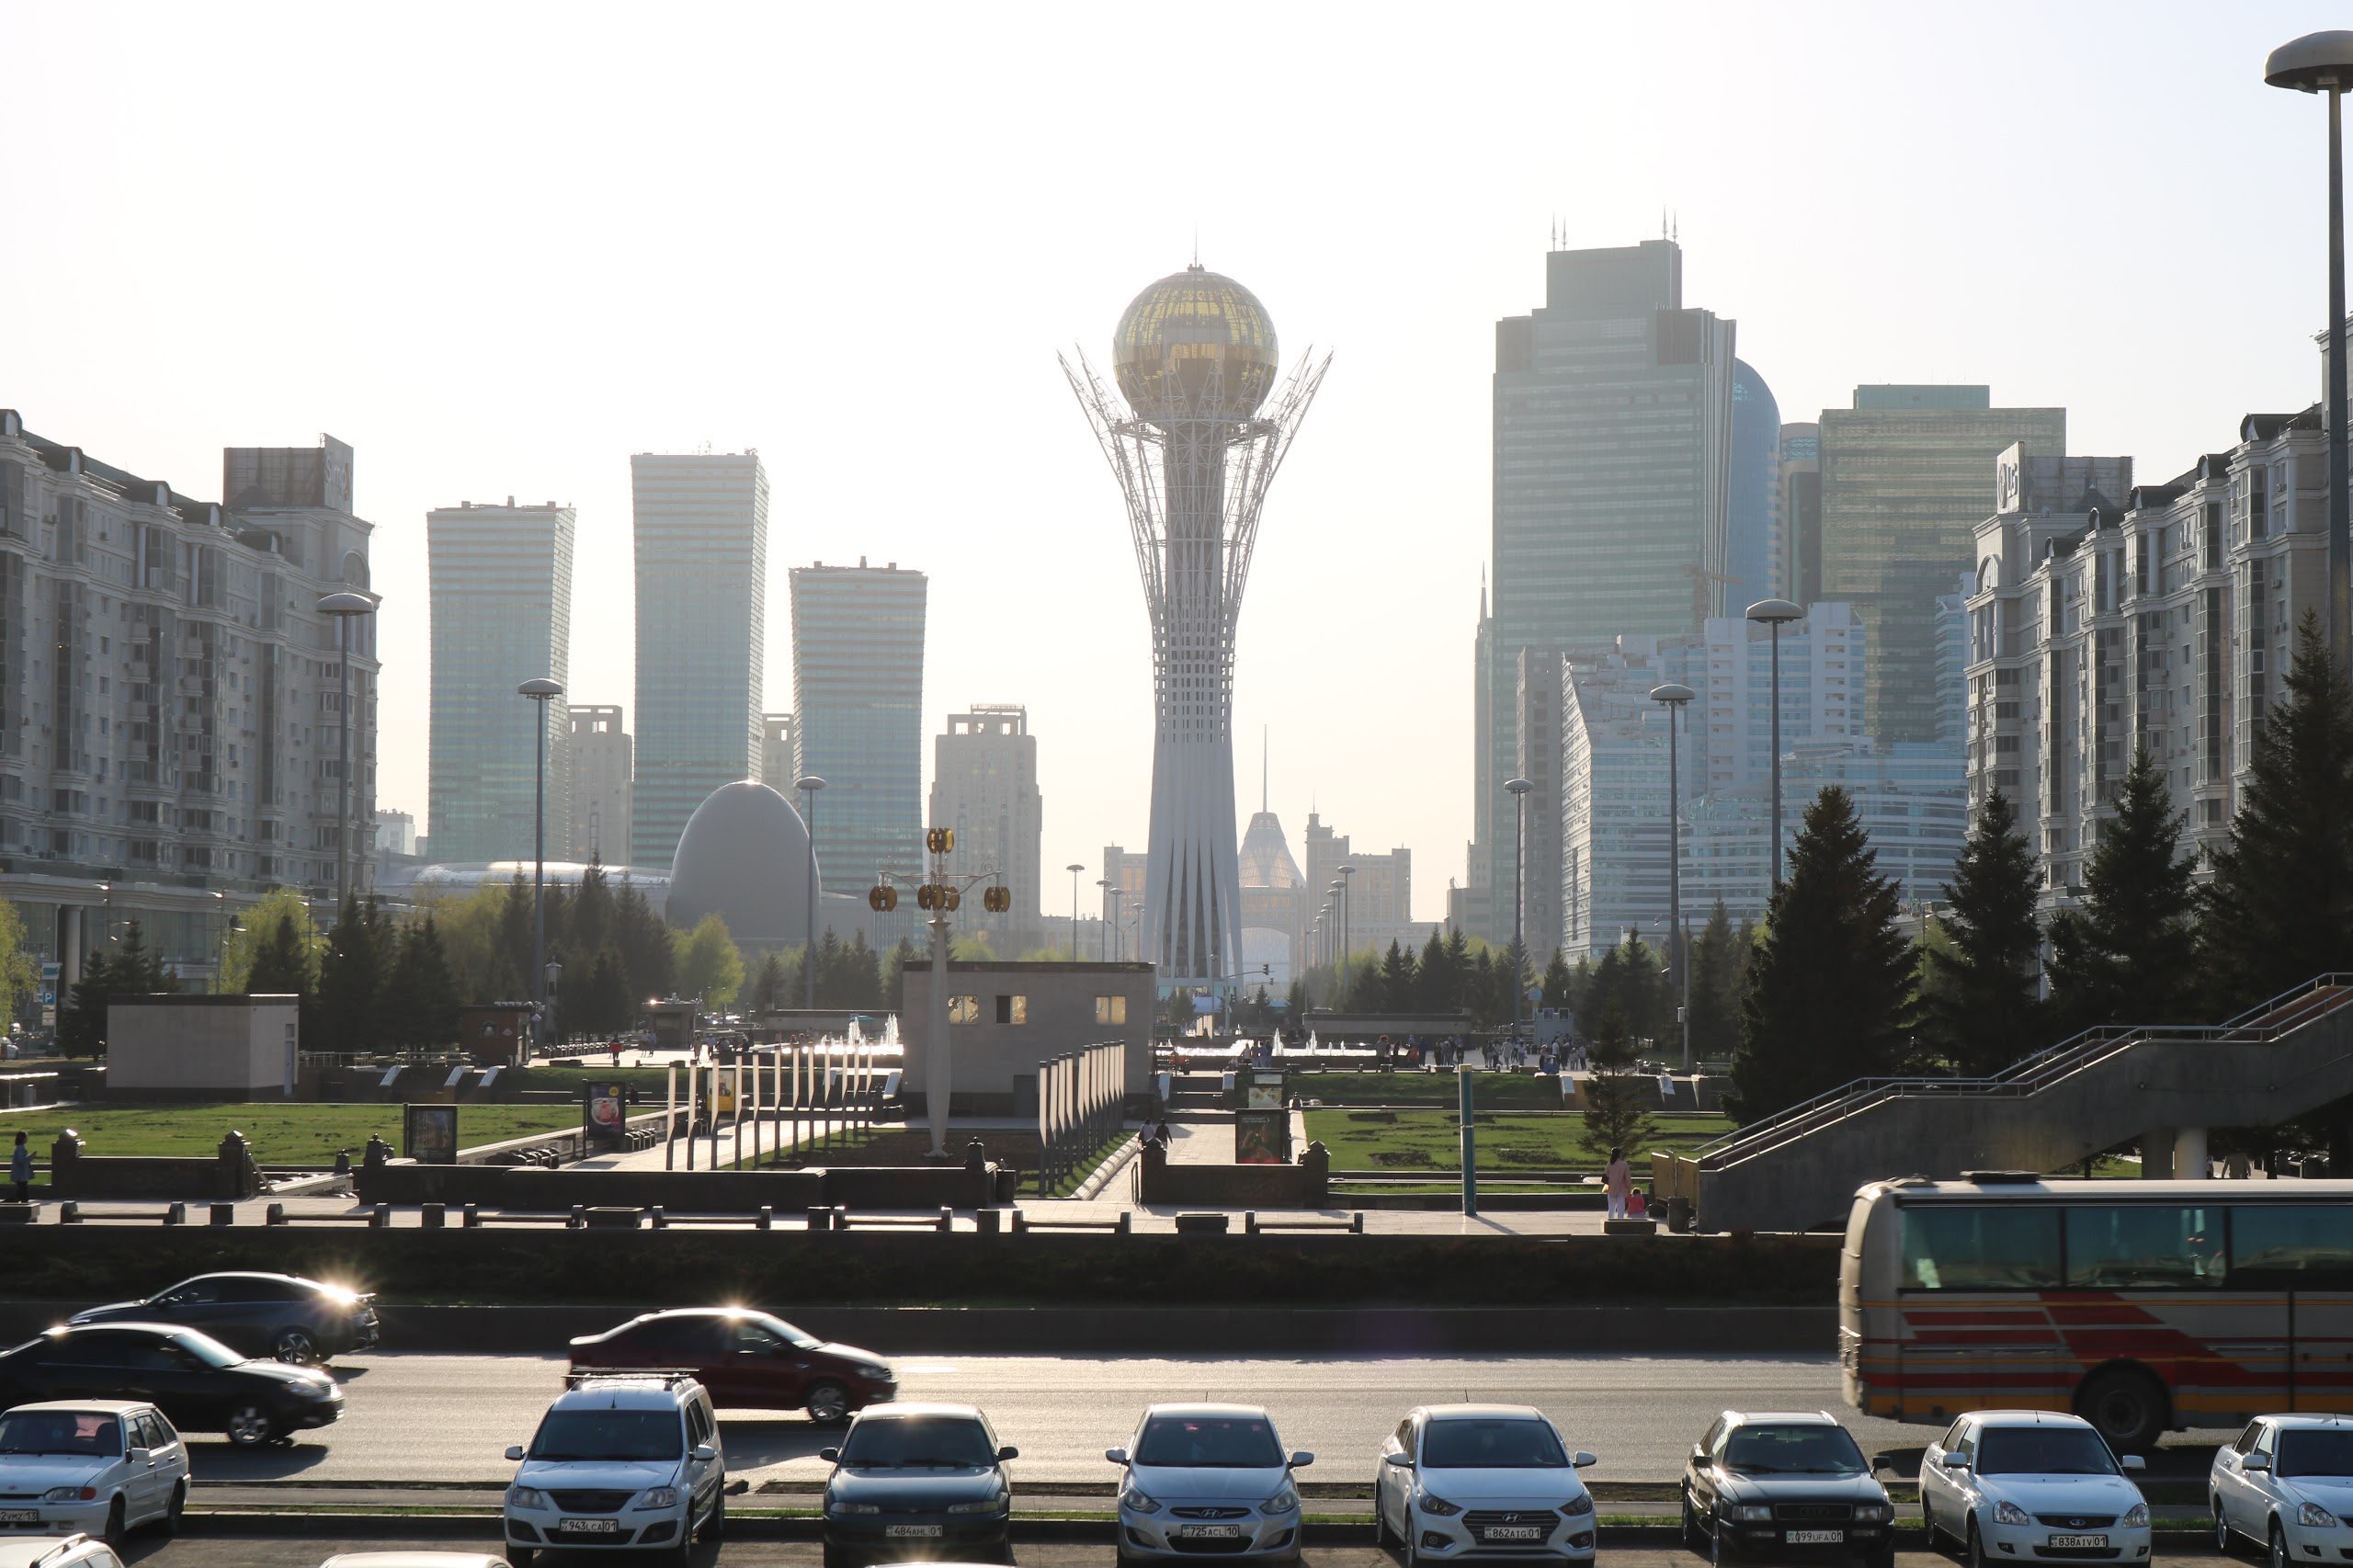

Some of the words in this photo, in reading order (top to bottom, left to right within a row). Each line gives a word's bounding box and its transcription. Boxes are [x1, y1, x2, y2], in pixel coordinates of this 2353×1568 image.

[2007, 463, 2018, 498] LG
[45, 993, 52, 1003] P
[1227, 1528, 1237, 1537] 10
[1529, 1528, 1540, 1538] 01
